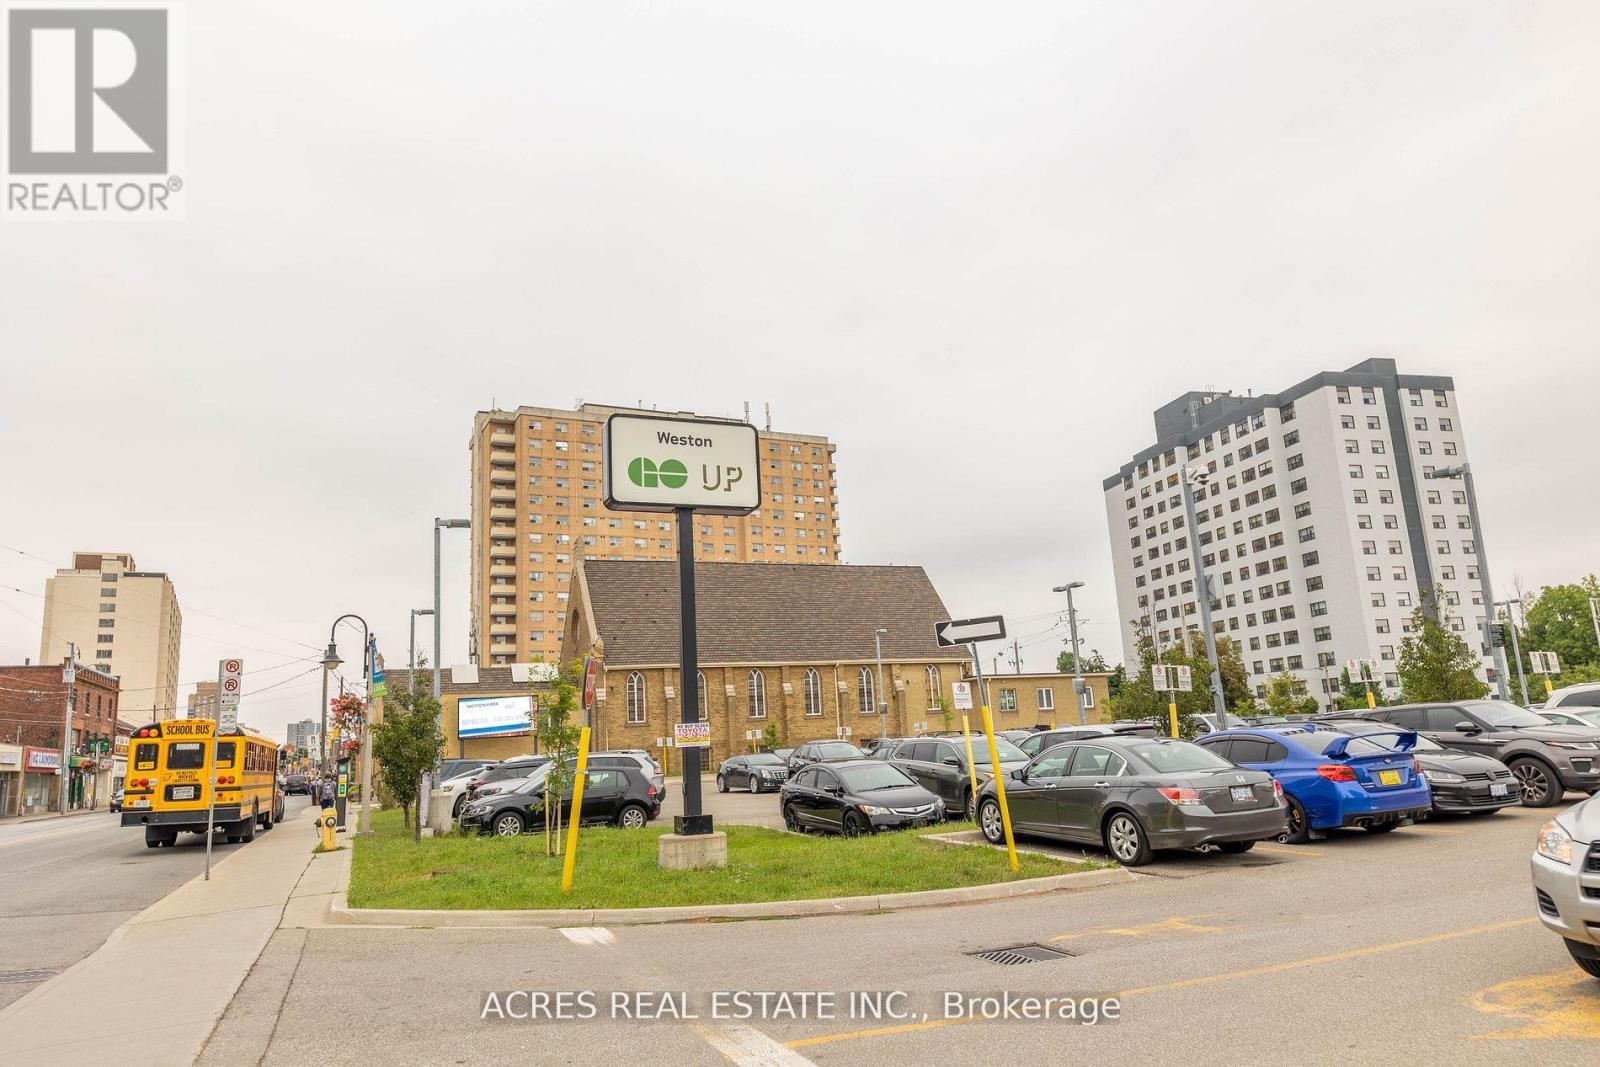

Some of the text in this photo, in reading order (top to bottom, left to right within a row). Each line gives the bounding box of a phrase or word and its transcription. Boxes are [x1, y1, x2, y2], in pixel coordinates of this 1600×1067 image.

[657, 431, 713, 448] Weston
[627, 456, 743, 492] GO UP
[166, 724, 210, 735] SCHOOL BUS
